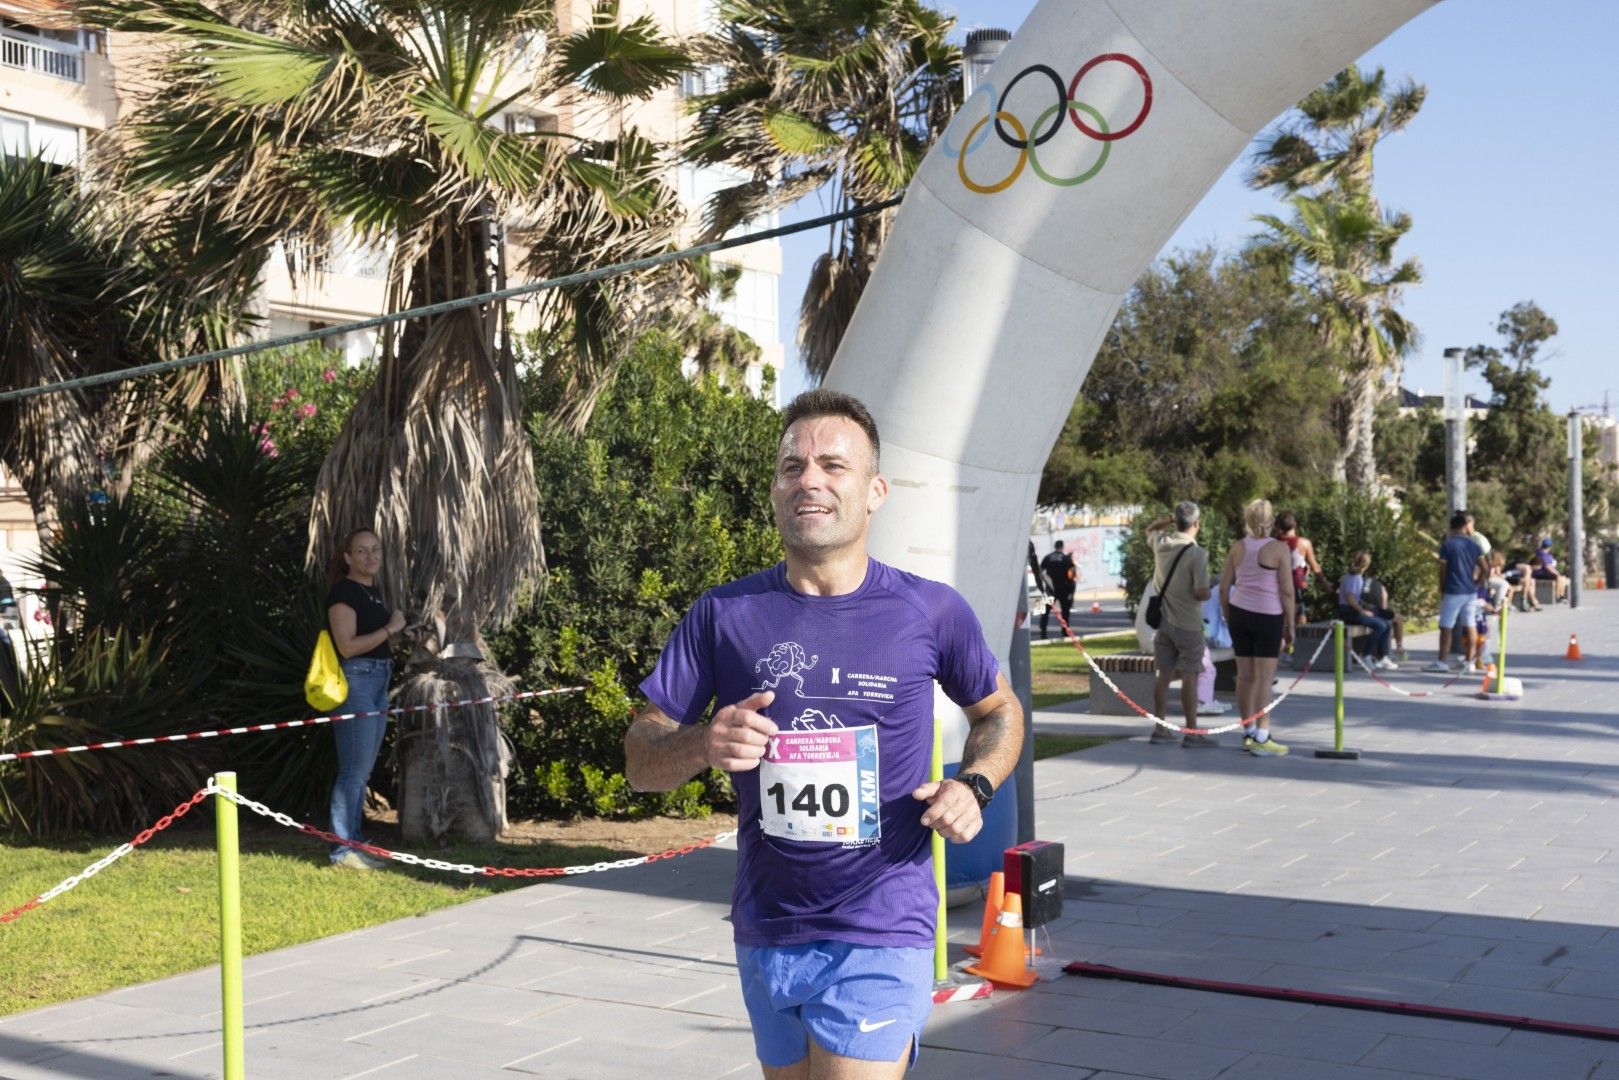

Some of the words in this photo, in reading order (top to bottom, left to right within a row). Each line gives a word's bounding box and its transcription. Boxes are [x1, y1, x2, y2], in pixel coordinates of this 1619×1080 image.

[831, 667, 840, 684] X
[847, 673, 898, 682] CARRERA/MARCHA
[858, 681, 887, 689] SOLIDARIA
[785, 736, 842, 745] CARRERA/MARCHA
[768, 737, 781, 760] X
[803, 751, 840, 760] TORREVIEJA
[861, 769, 877, 804] KM
[767, 782, 850, 818] 140
[862, 808, 877, 821] 7
